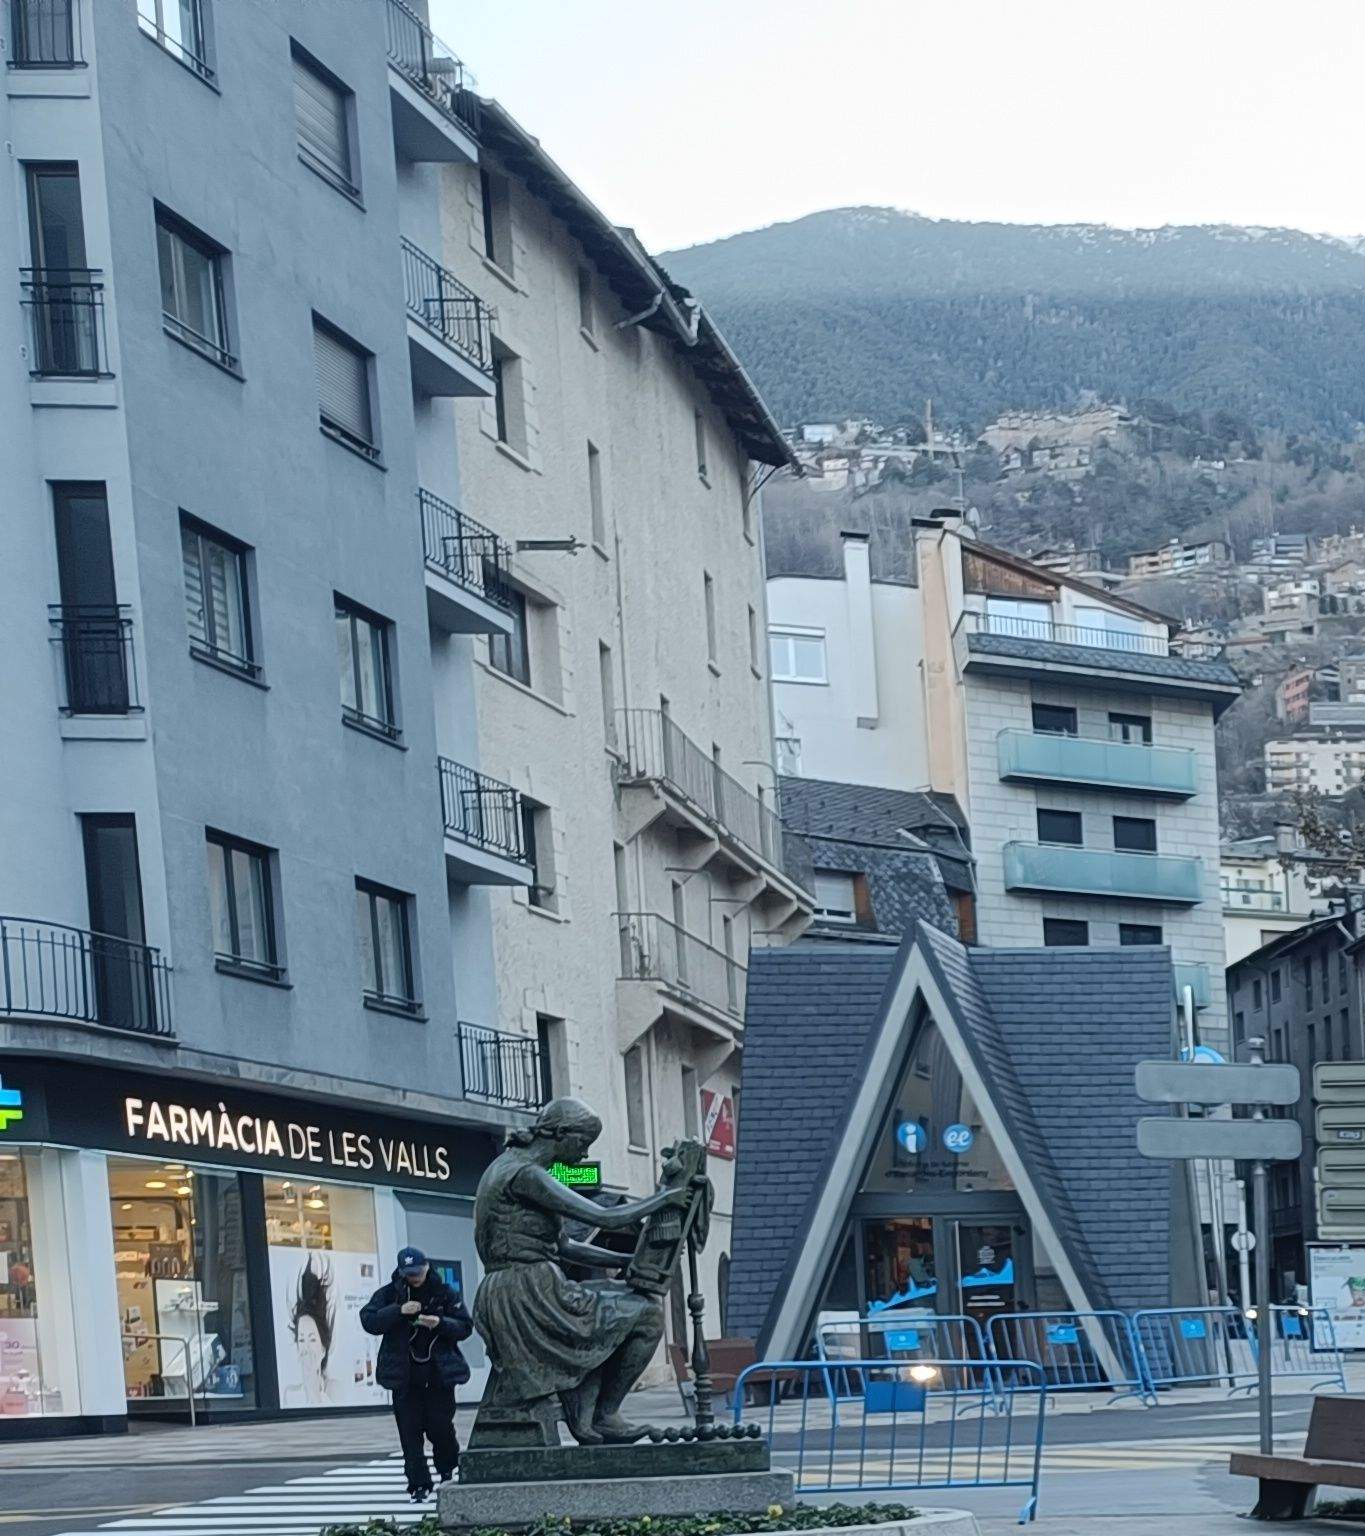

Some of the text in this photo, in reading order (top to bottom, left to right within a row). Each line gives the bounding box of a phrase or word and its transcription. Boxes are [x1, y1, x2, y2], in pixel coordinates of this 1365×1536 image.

[125, 1097, 450, 1181] FARMÀCIA DE LES VALLS
